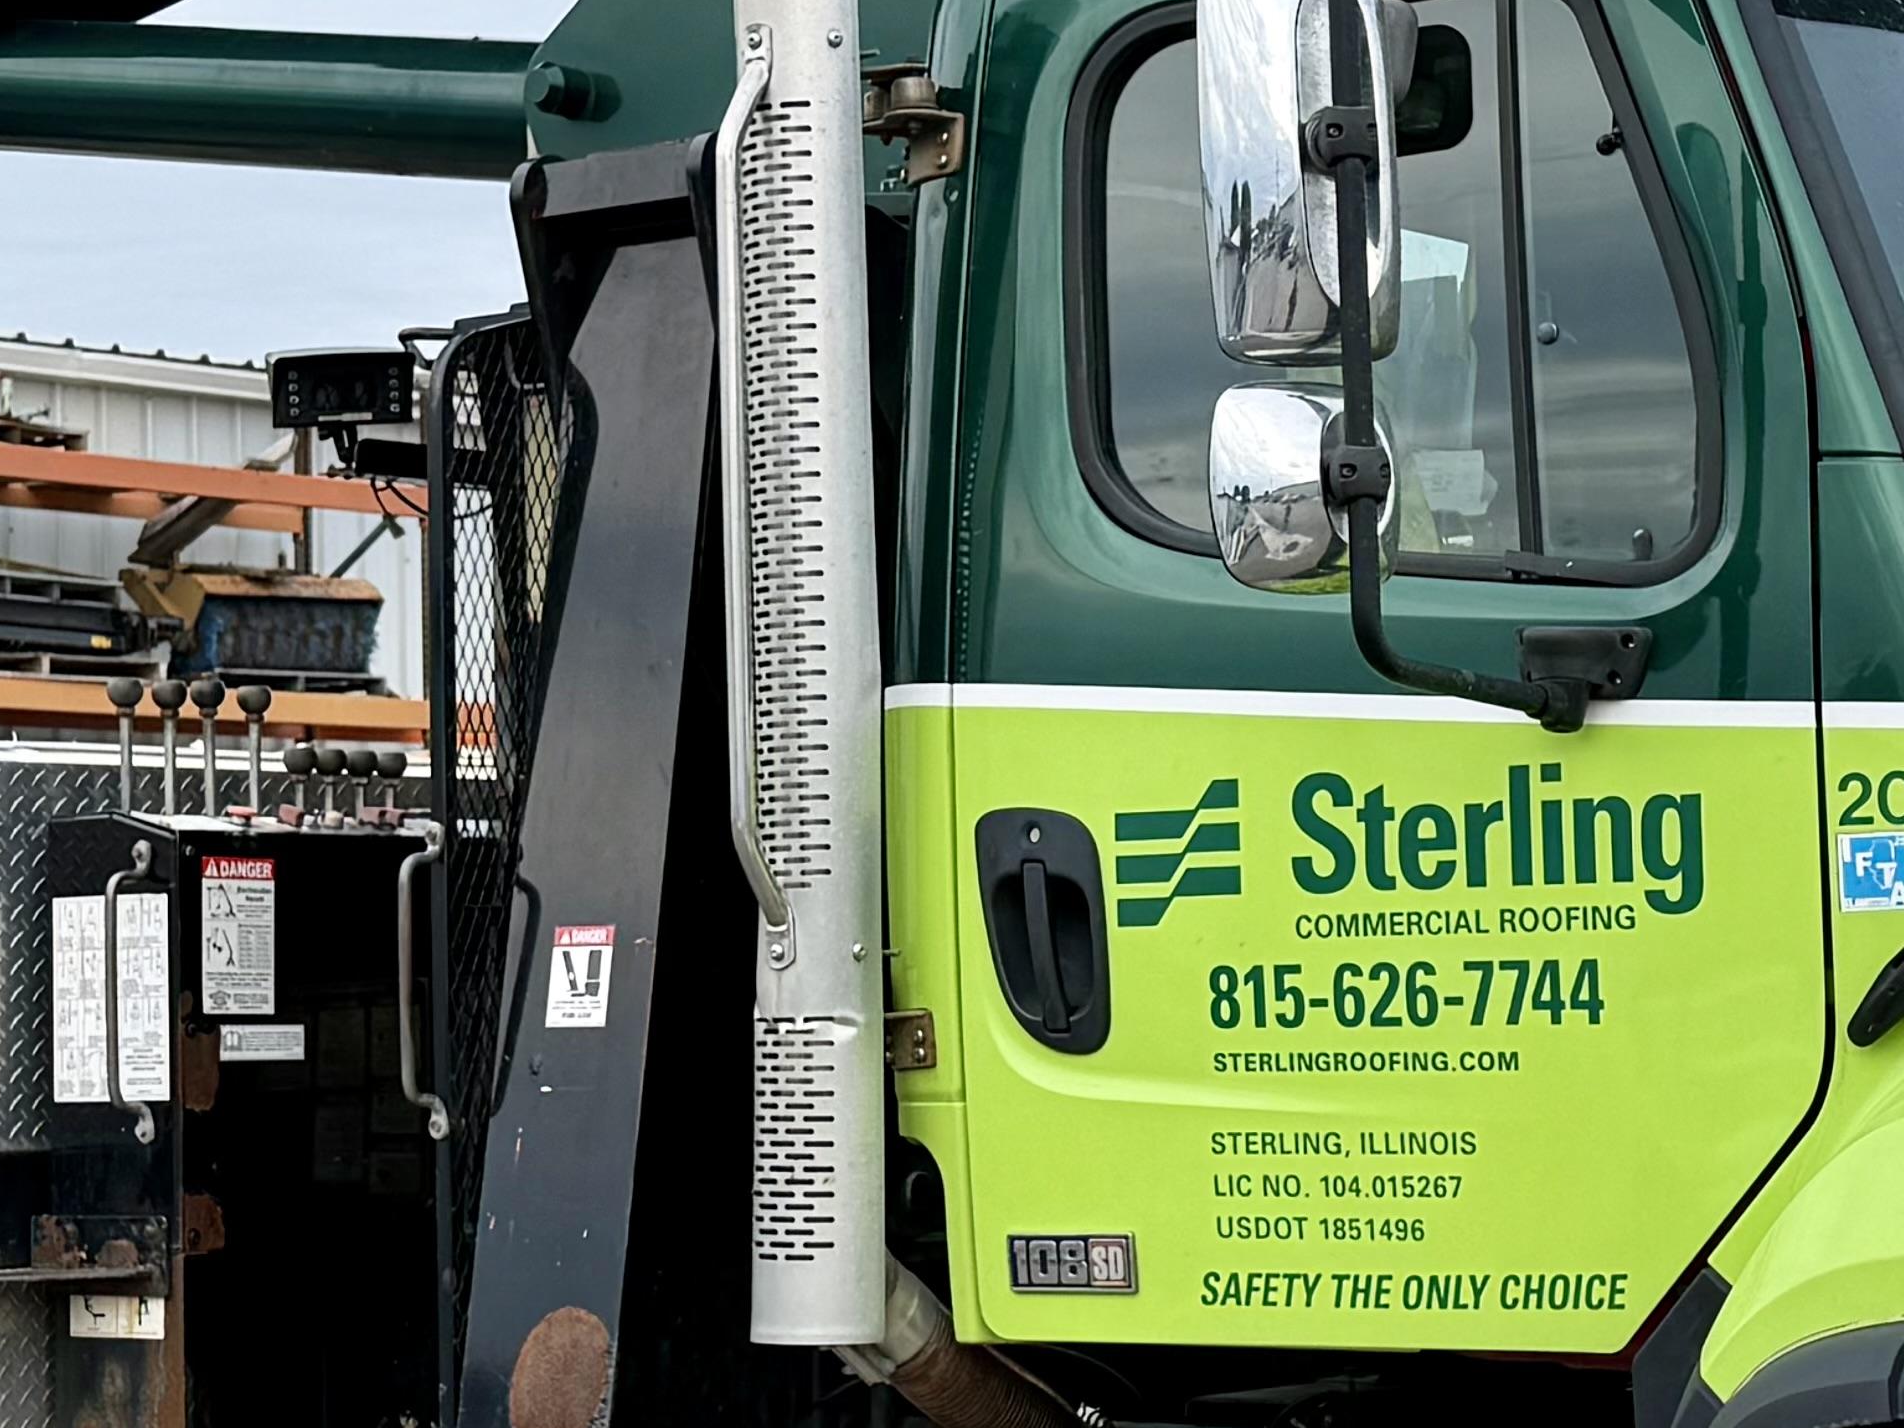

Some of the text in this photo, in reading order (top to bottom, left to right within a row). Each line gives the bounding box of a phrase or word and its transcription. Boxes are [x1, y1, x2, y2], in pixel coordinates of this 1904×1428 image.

[1291, 761, 1705, 915] Sterling
[219, 860, 273, 878] DANGER
[1295, 904, 1636, 940] COMMERCIAL ROOFING
[1208, 958, 1605, 1030] 815-626-7744
[1213, 1051, 1520, 1073] STERLINGROOFING.COM
[1211, 1131, 1477, 1159] STERLING, ILLINOIS
[1213, 1174, 1463, 1199] LIC NO. 104.015267
[1216, 1216, 1425, 1242] USDOT 1851496
[1013, 1239, 1125, 1285] 108 SD
[1200, 1271, 1629, 1311] SAFETY THE ONLY CHOICE
